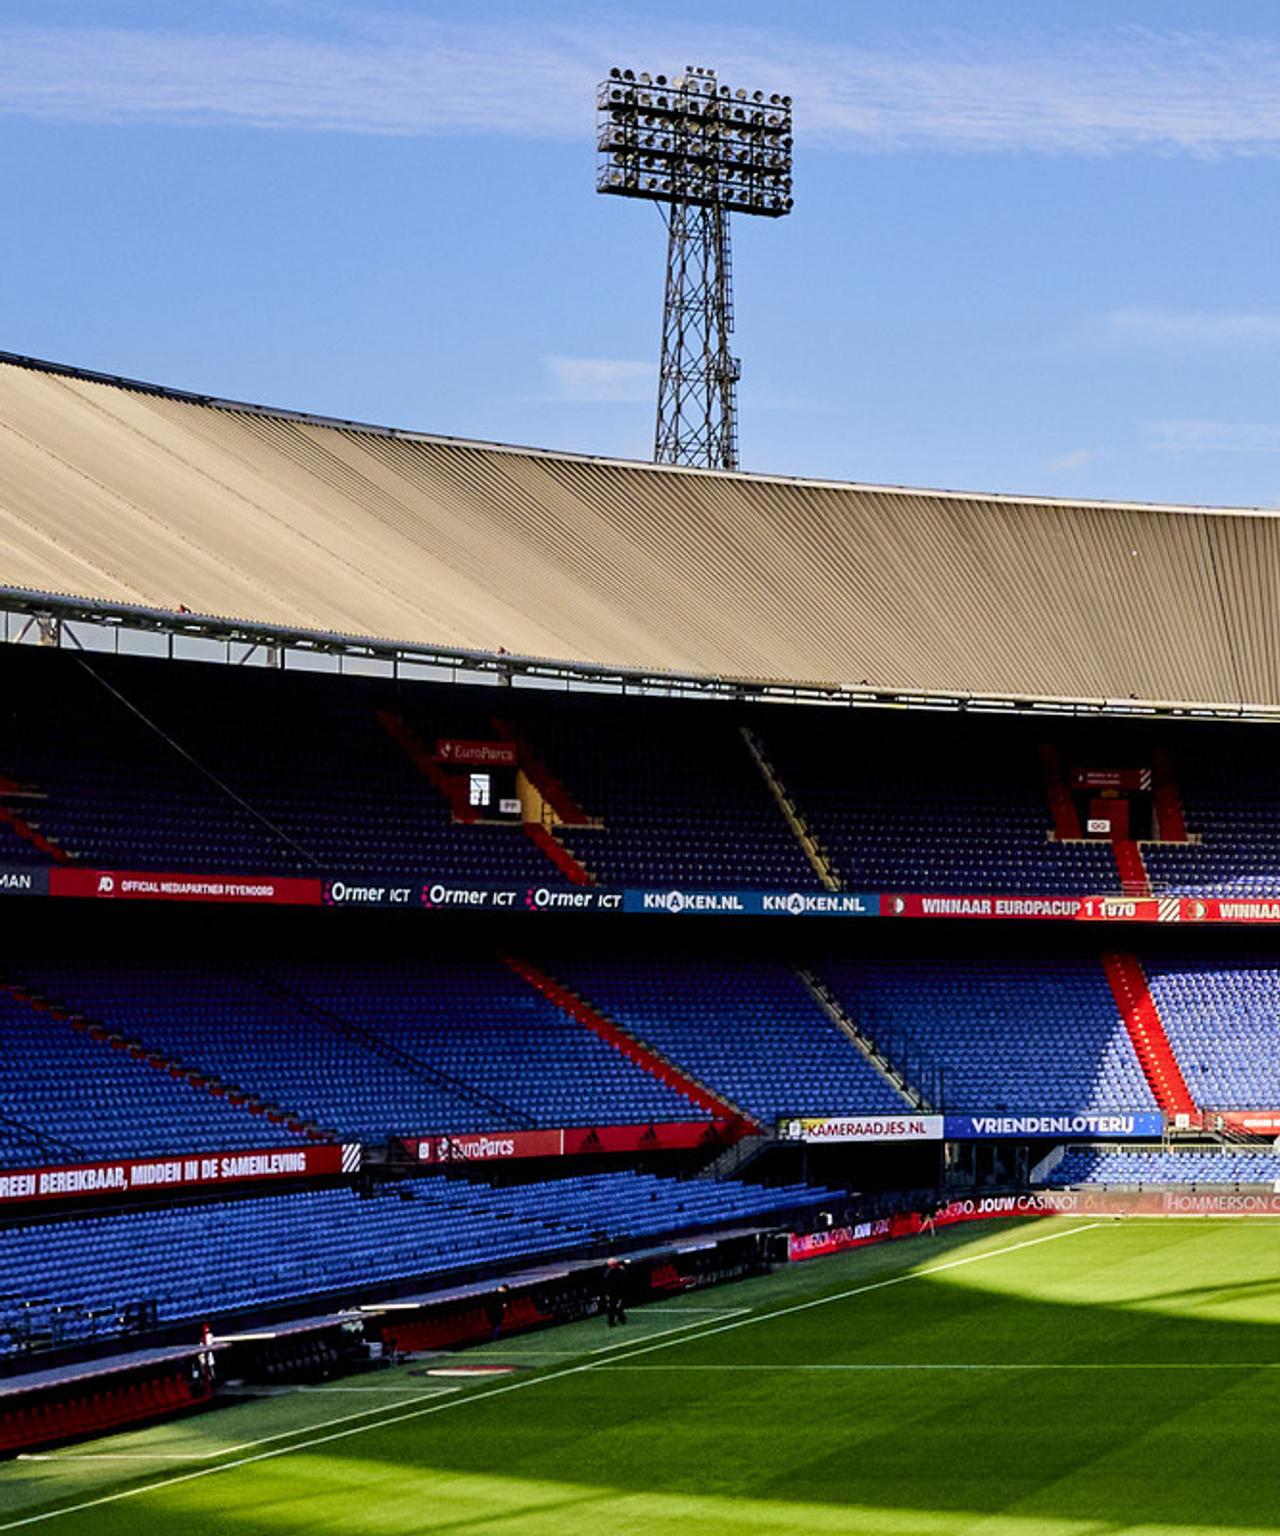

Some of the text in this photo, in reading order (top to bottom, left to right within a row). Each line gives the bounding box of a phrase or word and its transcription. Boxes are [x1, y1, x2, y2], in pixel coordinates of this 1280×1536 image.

[455, 745, 513, 761] EuroParcs
[121, 882, 159, 893] OFFICIAL
[161, 883, 223, 895] MEDIAPARTNER
[225, 885, 274, 896] FEYENOORD
[331, 882, 411, 902] Ormer ICT
[429, 884, 516, 905] Ormer ICT
[534, 888, 622, 908] Ormer ICT
[643, 891, 743, 913] KNAKEN.NL
[762, 893, 865, 914] KNAKEN.NL
[922, 898, 1136, 917] WINNAAR EUROPACUP 1 1970
[808, 1121, 926, 1137] KAMERAADJES.NL
[39, 1167, 128, 1192] BEREIKBAAR,
[131, 1161, 181, 1186] MIDDEN
[184, 1160, 198, 1181] IN
[201, 1158, 218, 1180] DE
[221, 1152, 306, 1178] SAMENLEVING
[978, 1197, 1015, 1213] JOUW
[1167, 1196, 1267, 1210] HOMMERSON
